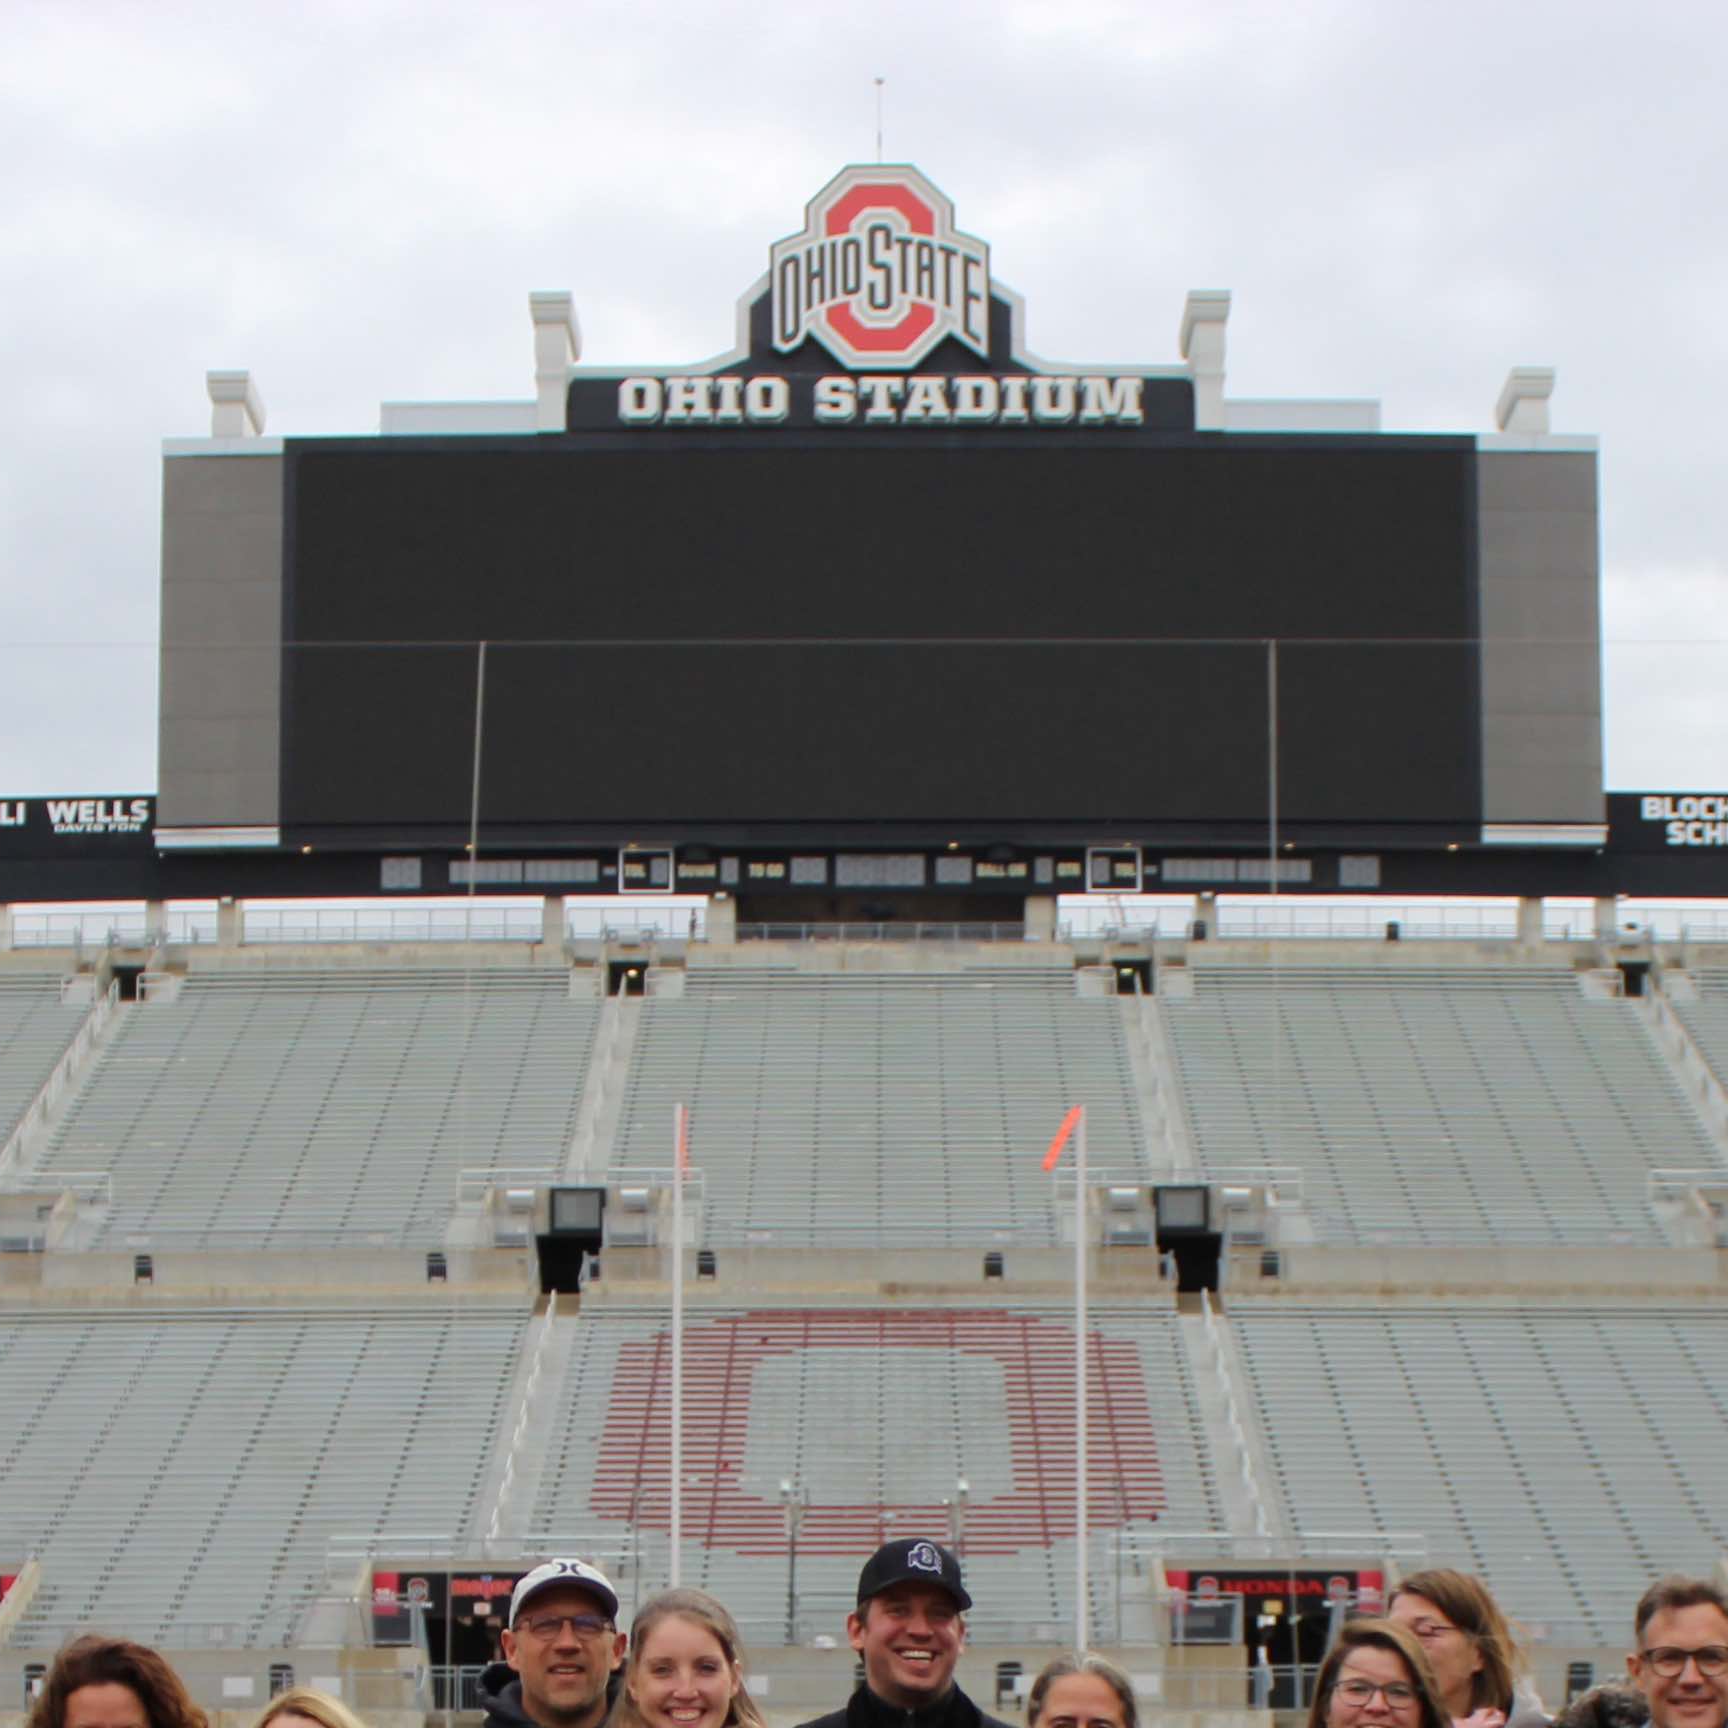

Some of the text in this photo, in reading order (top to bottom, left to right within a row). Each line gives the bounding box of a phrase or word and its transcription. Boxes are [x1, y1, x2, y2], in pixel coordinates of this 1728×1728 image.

[618, 376, 1143, 424] OHIO STADIUM
[46, 800, 149, 823] WELLS
[1224, 1580, 1324, 1595] HONDA
